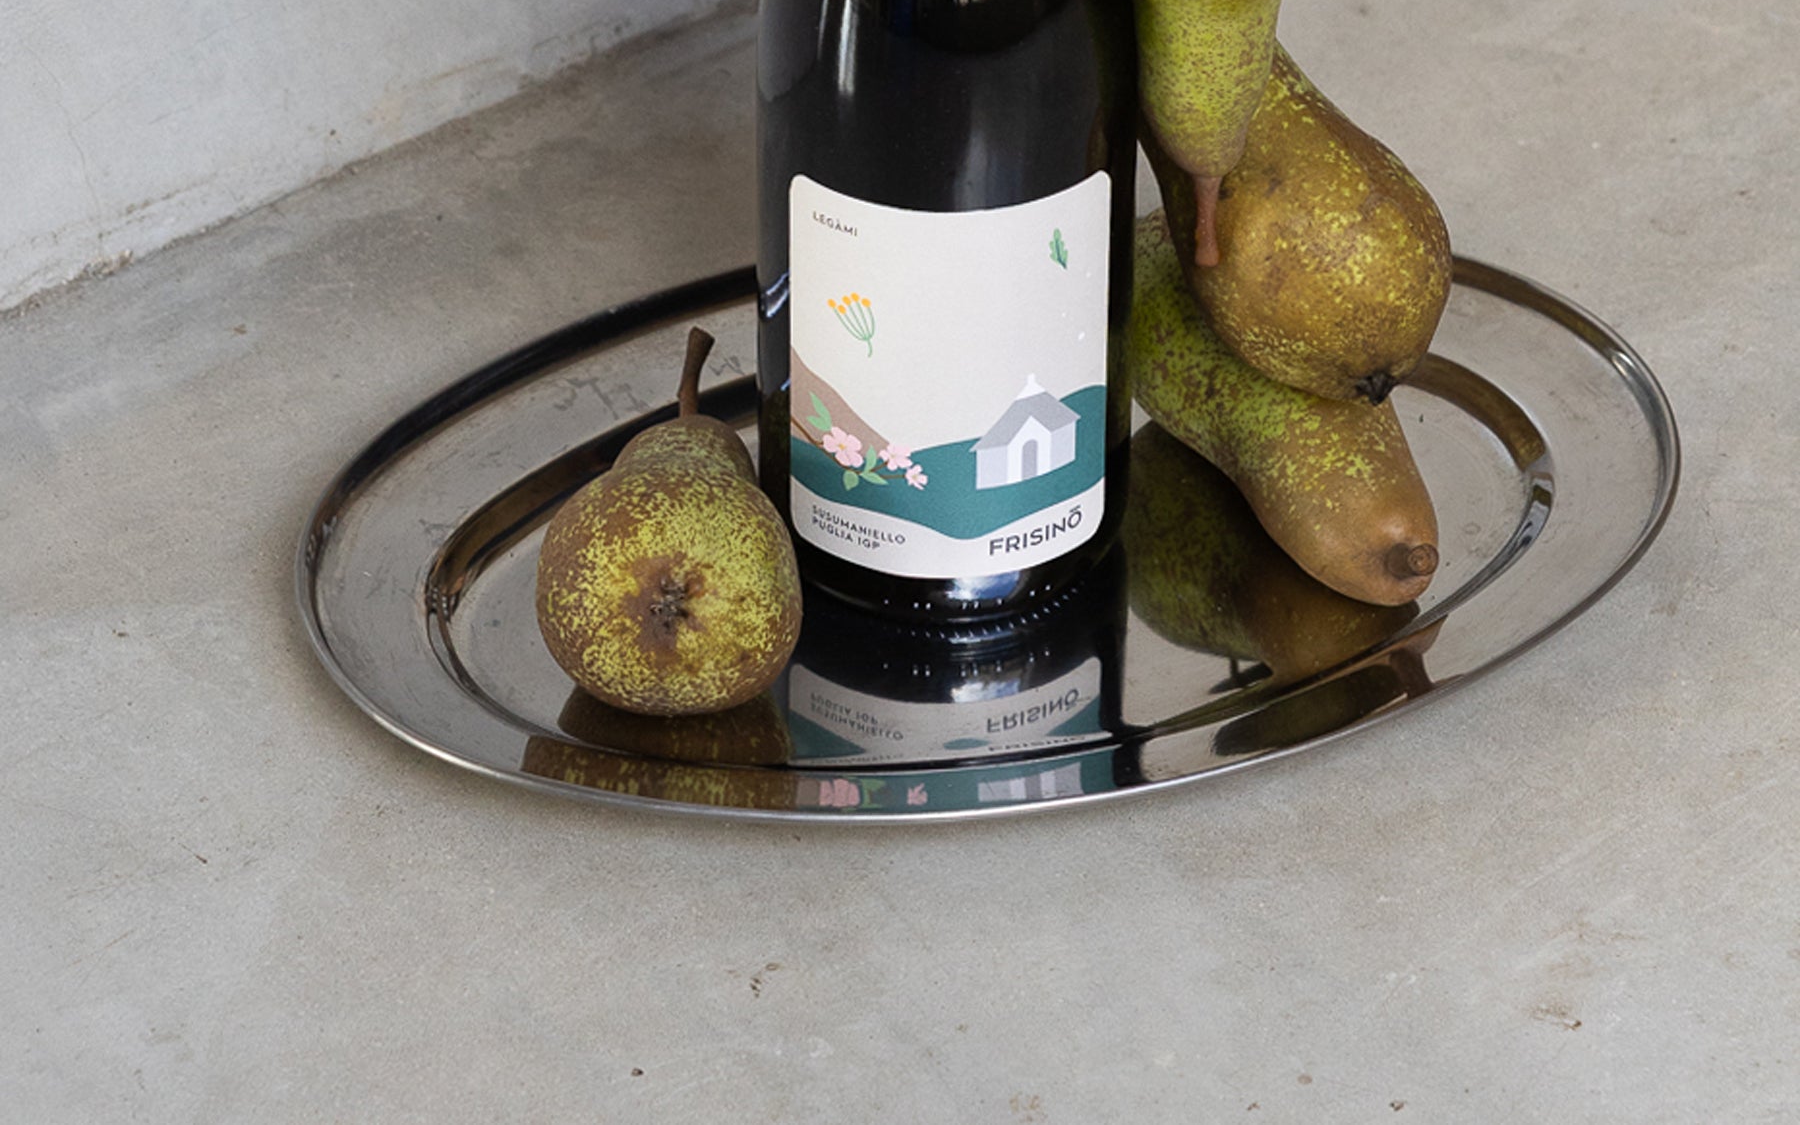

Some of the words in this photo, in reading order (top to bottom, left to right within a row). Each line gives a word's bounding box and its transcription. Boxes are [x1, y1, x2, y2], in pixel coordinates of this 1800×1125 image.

[812, 504, 906, 544] SUSUMANIELLO
[812, 516, 853, 542] PUGLIA
[857, 537, 881, 550] IGP
